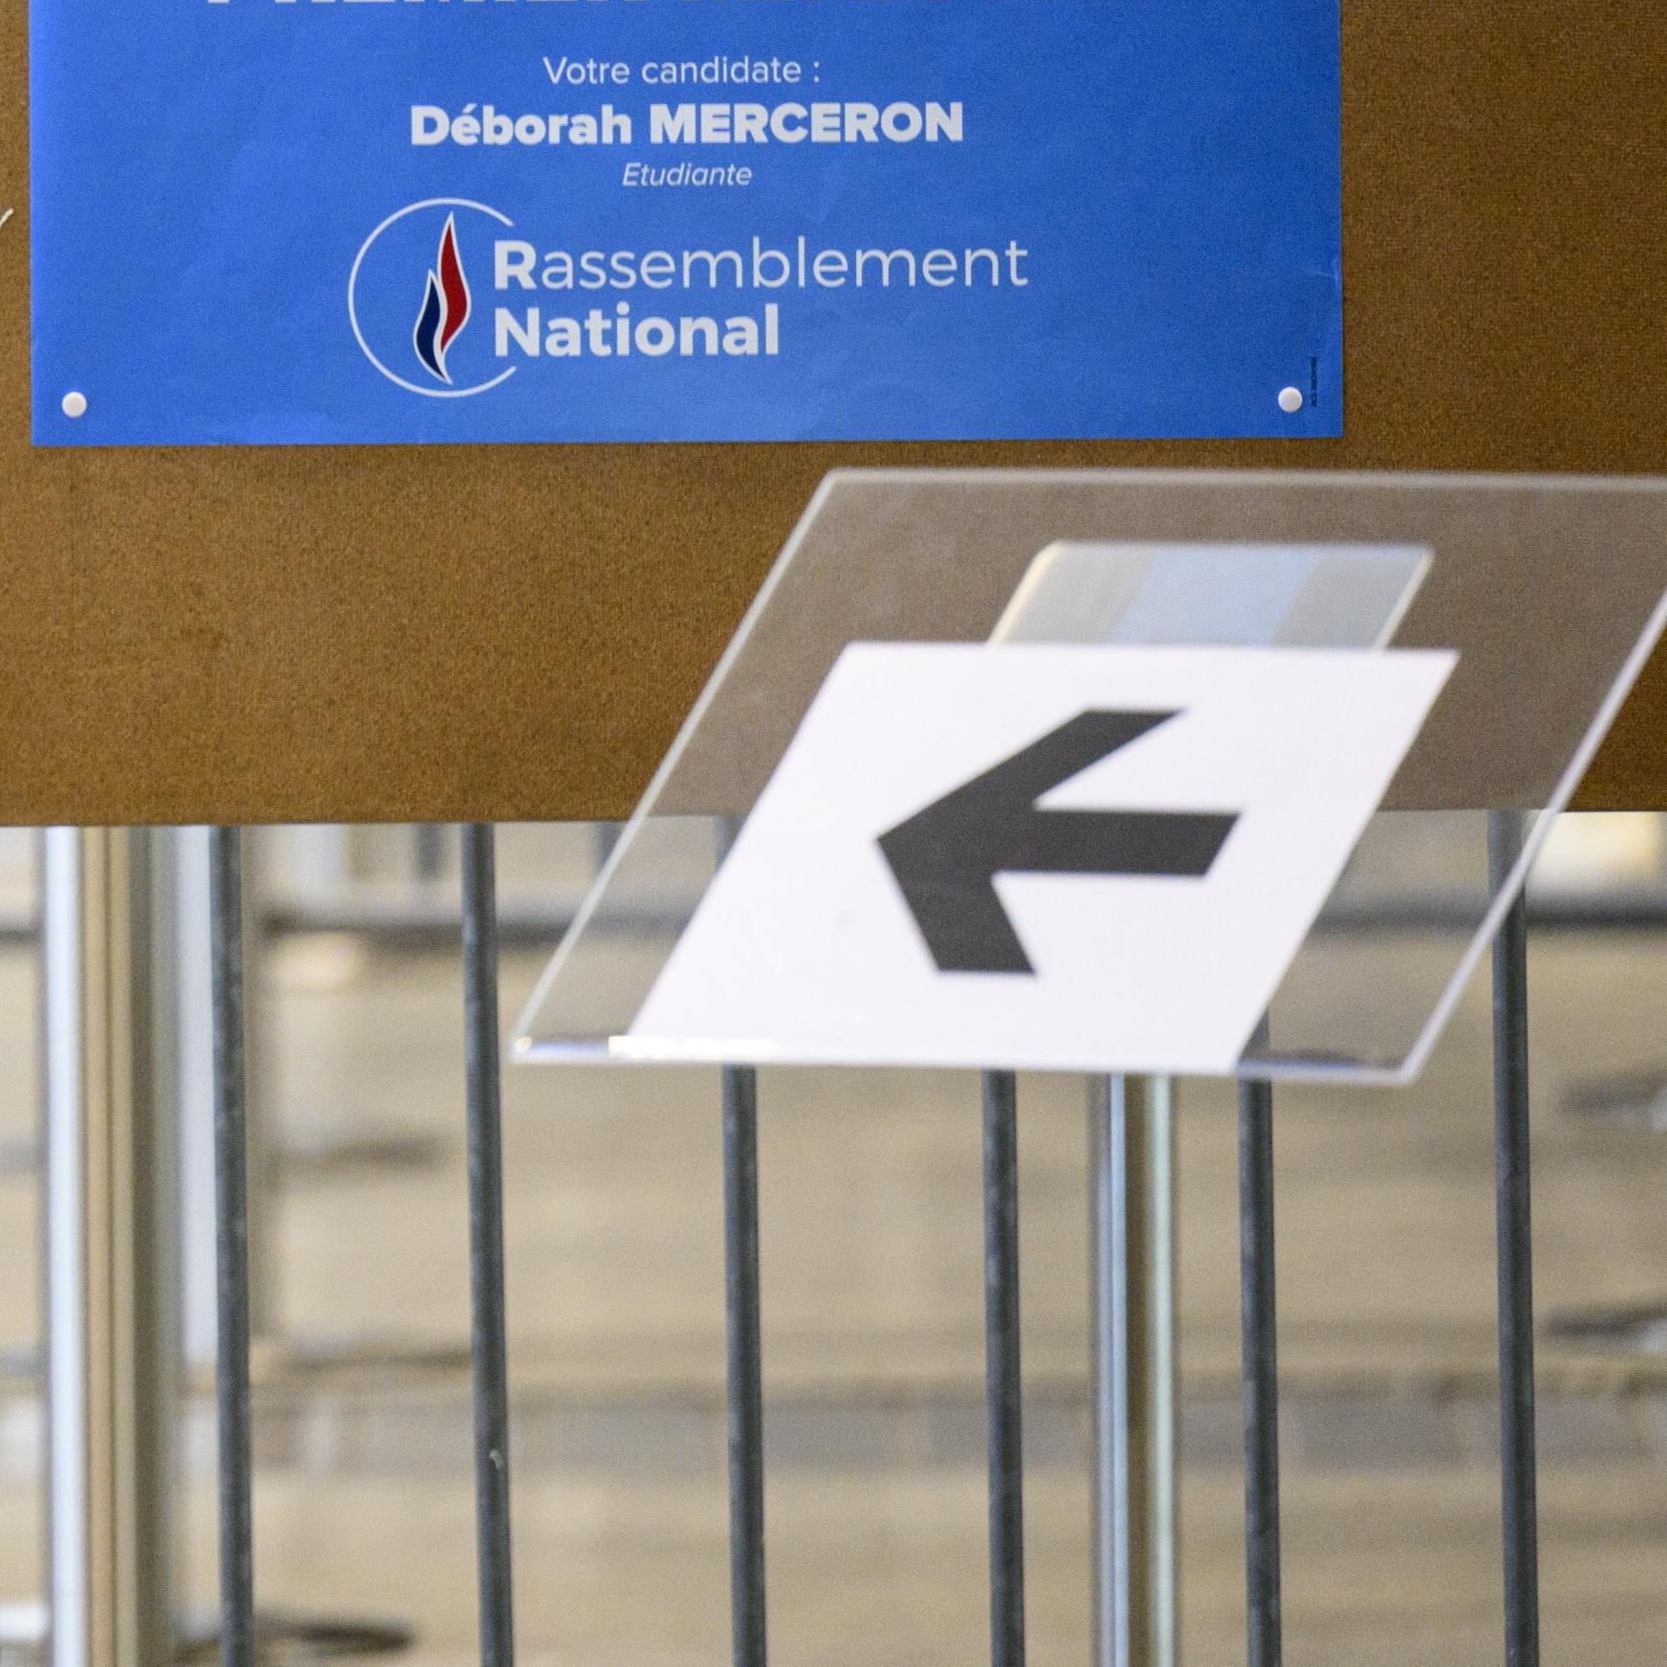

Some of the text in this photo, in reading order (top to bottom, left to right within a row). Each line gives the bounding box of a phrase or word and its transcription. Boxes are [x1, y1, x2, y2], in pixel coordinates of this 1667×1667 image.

[542, 56, 631, 86] Votre
[641, 55, 802, 85] candidate
[410, 101, 965, 147] Déborah MERCERON
[621, 161, 754, 188] Etudiante
[493, 234, 1030, 291] Rassemblement
[494, 301, 780, 359] National
